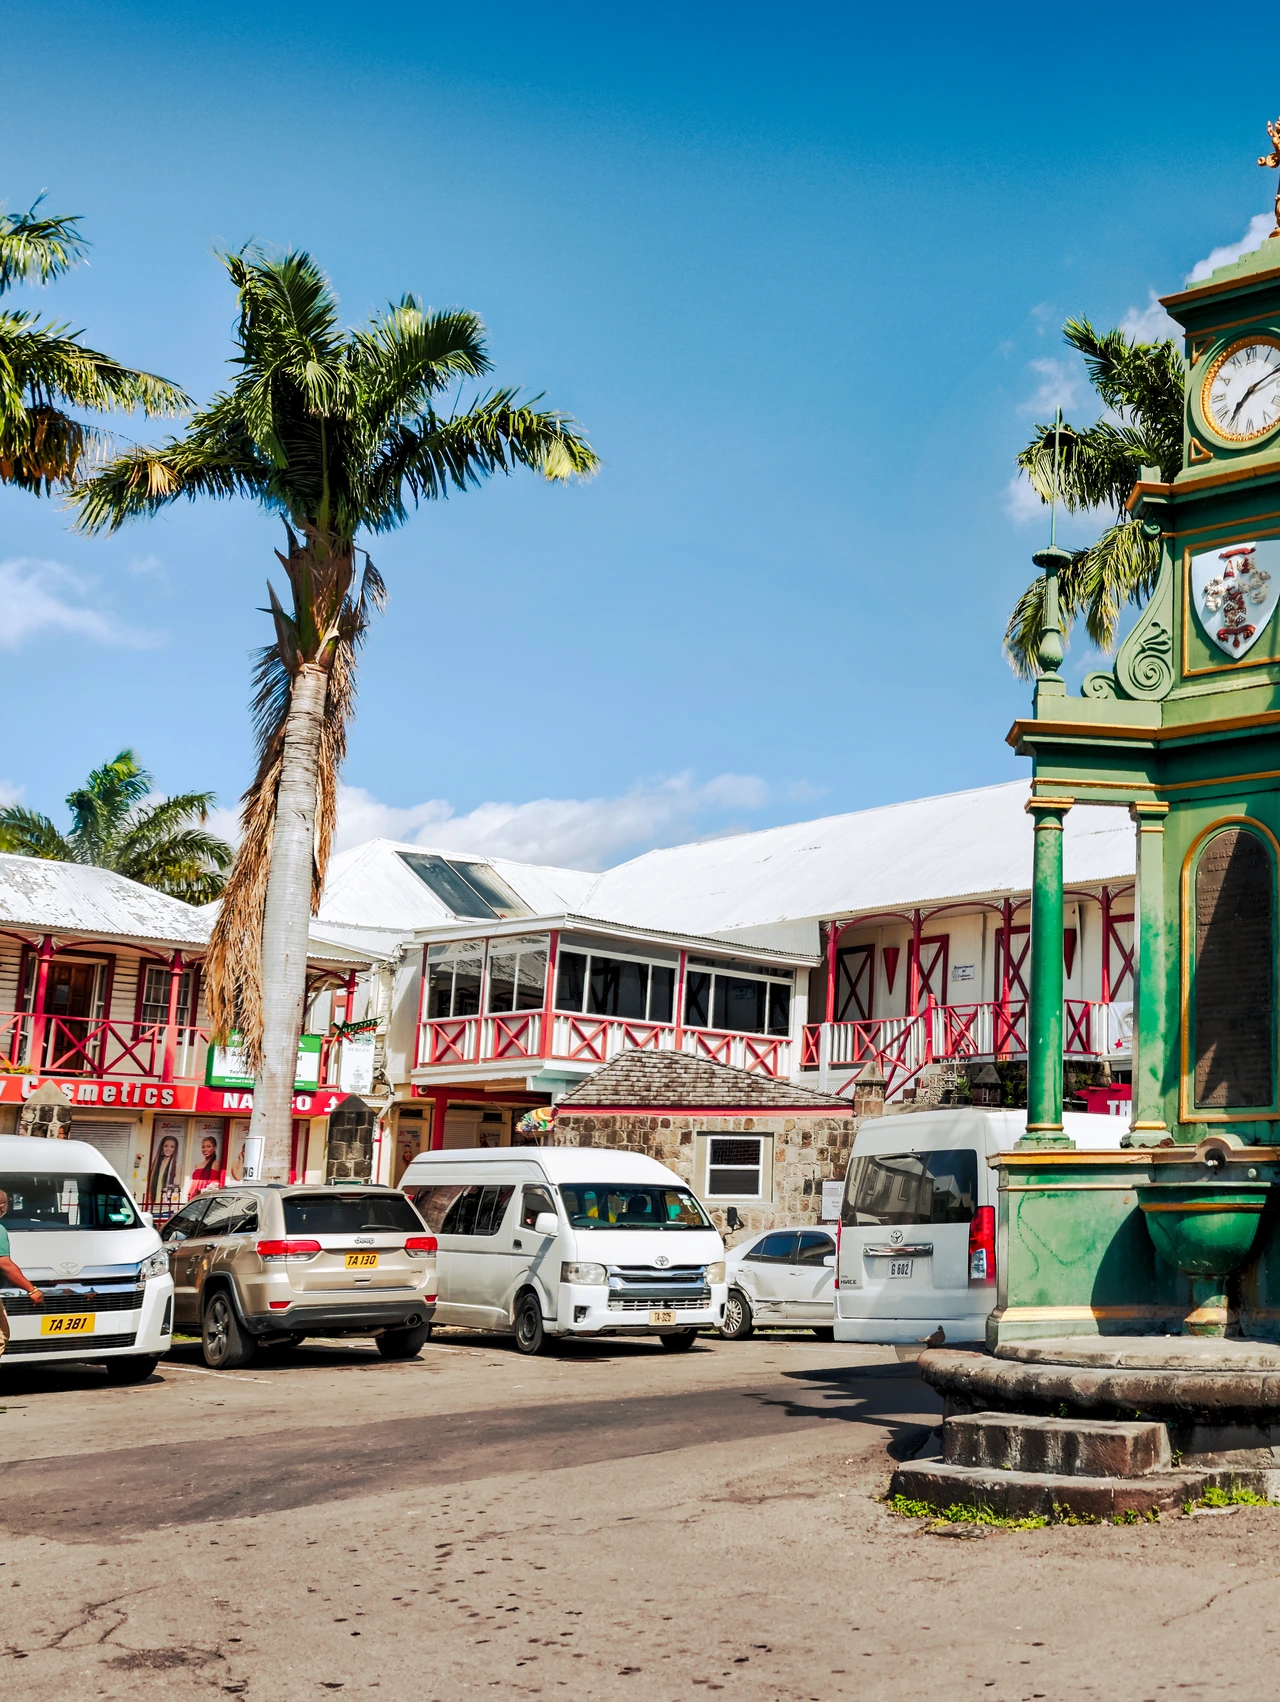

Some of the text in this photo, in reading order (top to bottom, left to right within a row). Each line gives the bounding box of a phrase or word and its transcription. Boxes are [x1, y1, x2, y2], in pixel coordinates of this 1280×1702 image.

[22, 1076, 175, 1106] Csmetics
[354, 1236, 376, 1245] Jeep
[347, 1255, 377, 1266] TA 130
[897, 1263, 909, 1275] 602
[49, 1317, 88, 1331] TA 381
